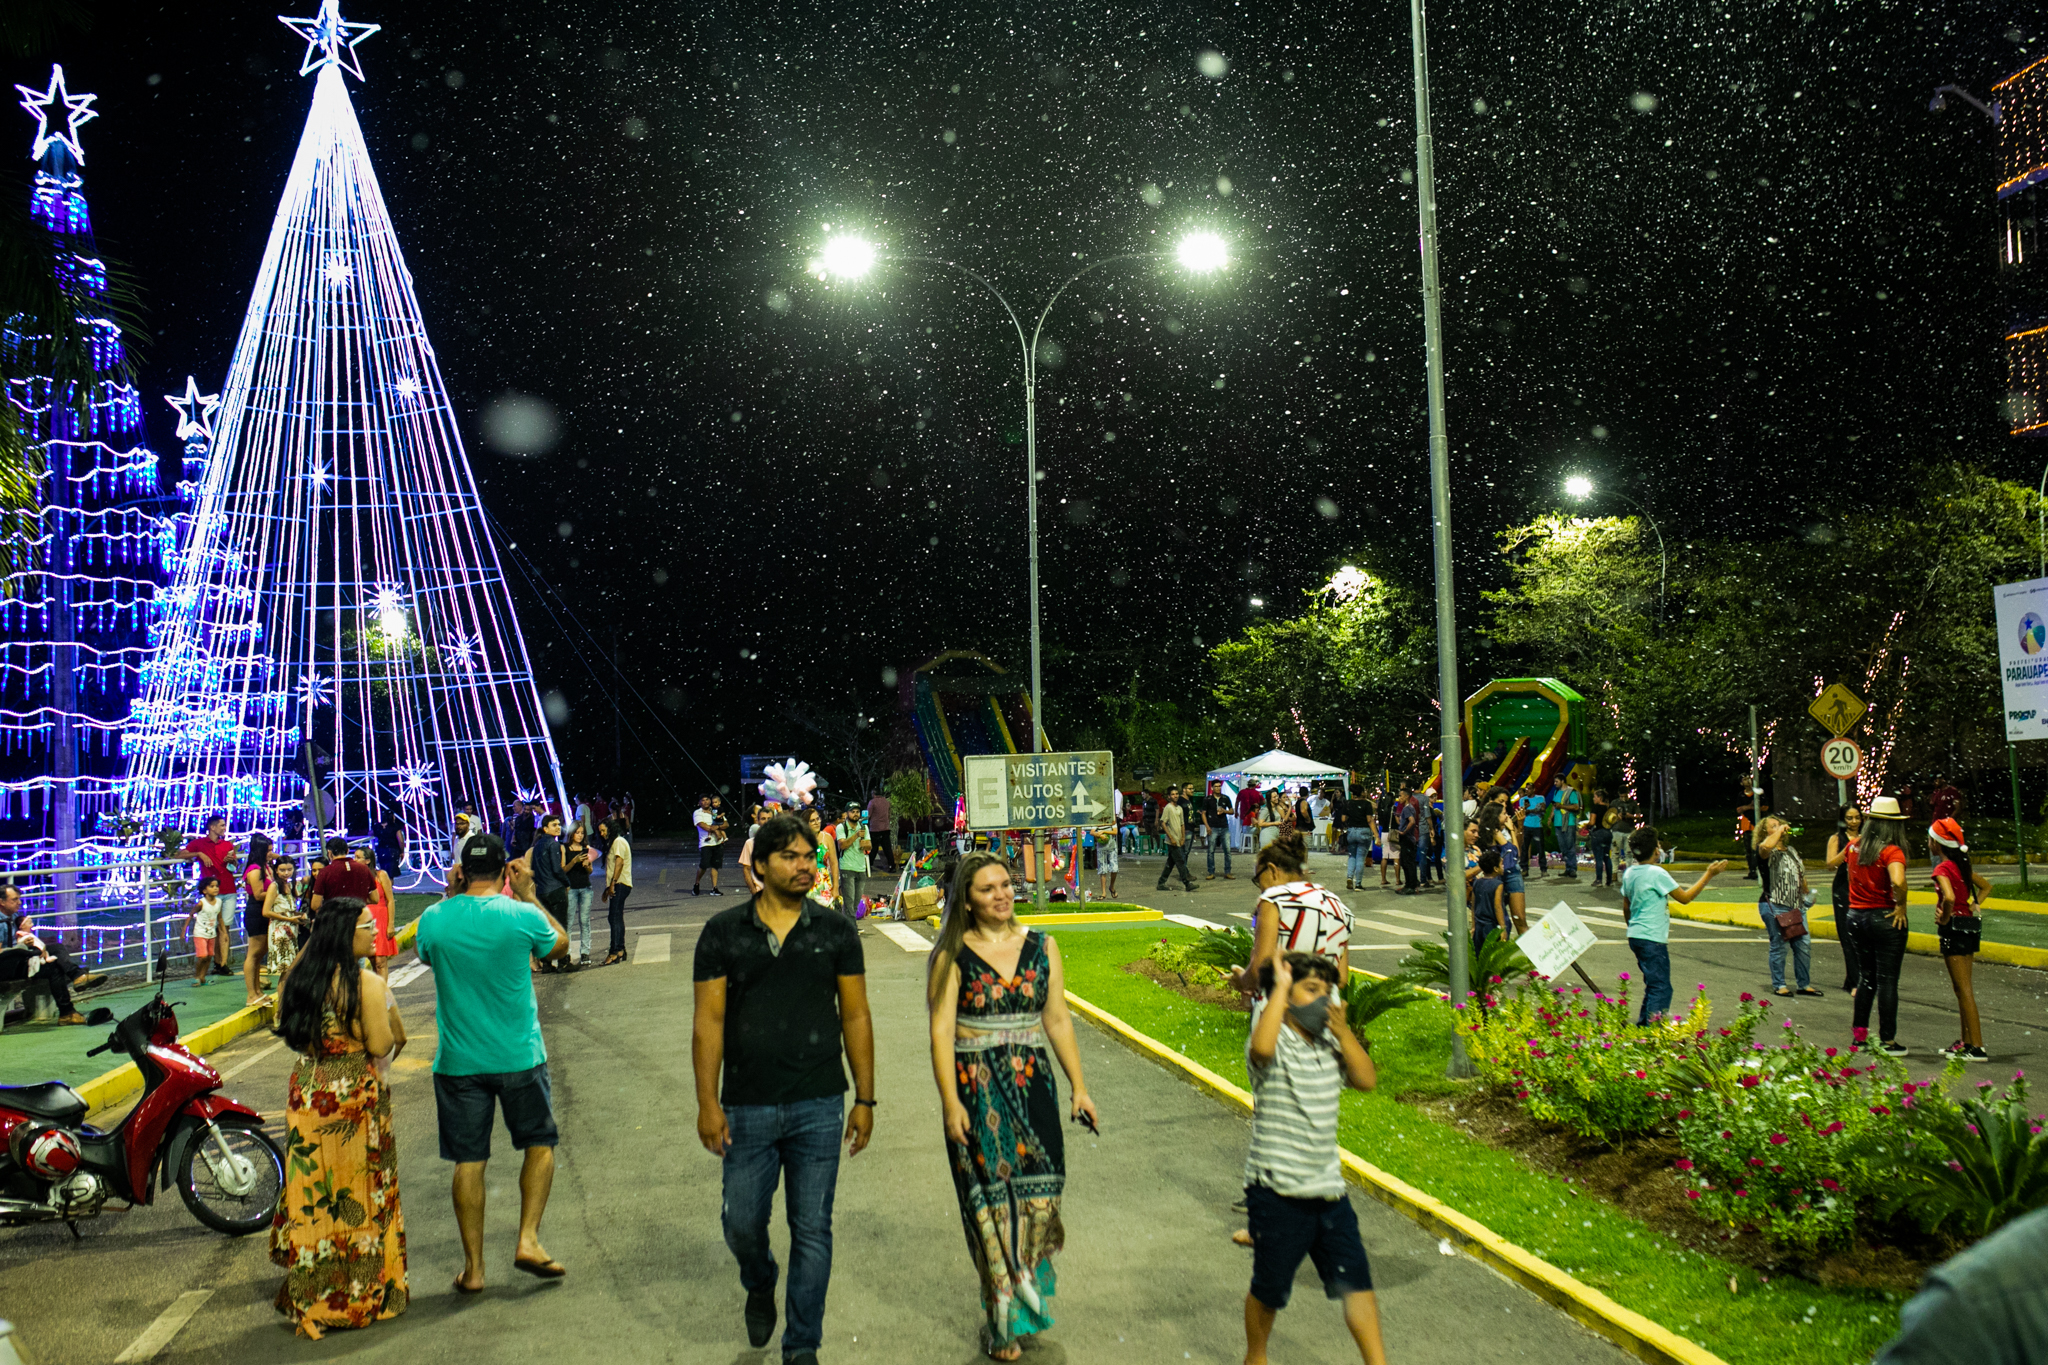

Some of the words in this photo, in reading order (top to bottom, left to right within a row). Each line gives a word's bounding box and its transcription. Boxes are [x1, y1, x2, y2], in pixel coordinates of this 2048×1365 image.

[1828, 746, 1854, 764] 20
[1011, 761, 1096, 777] VISITANTES
[977, 777, 1000, 809] E
[1013, 783, 1064, 799] AUTOS
[1013, 804, 1065, 820] MOTOS
